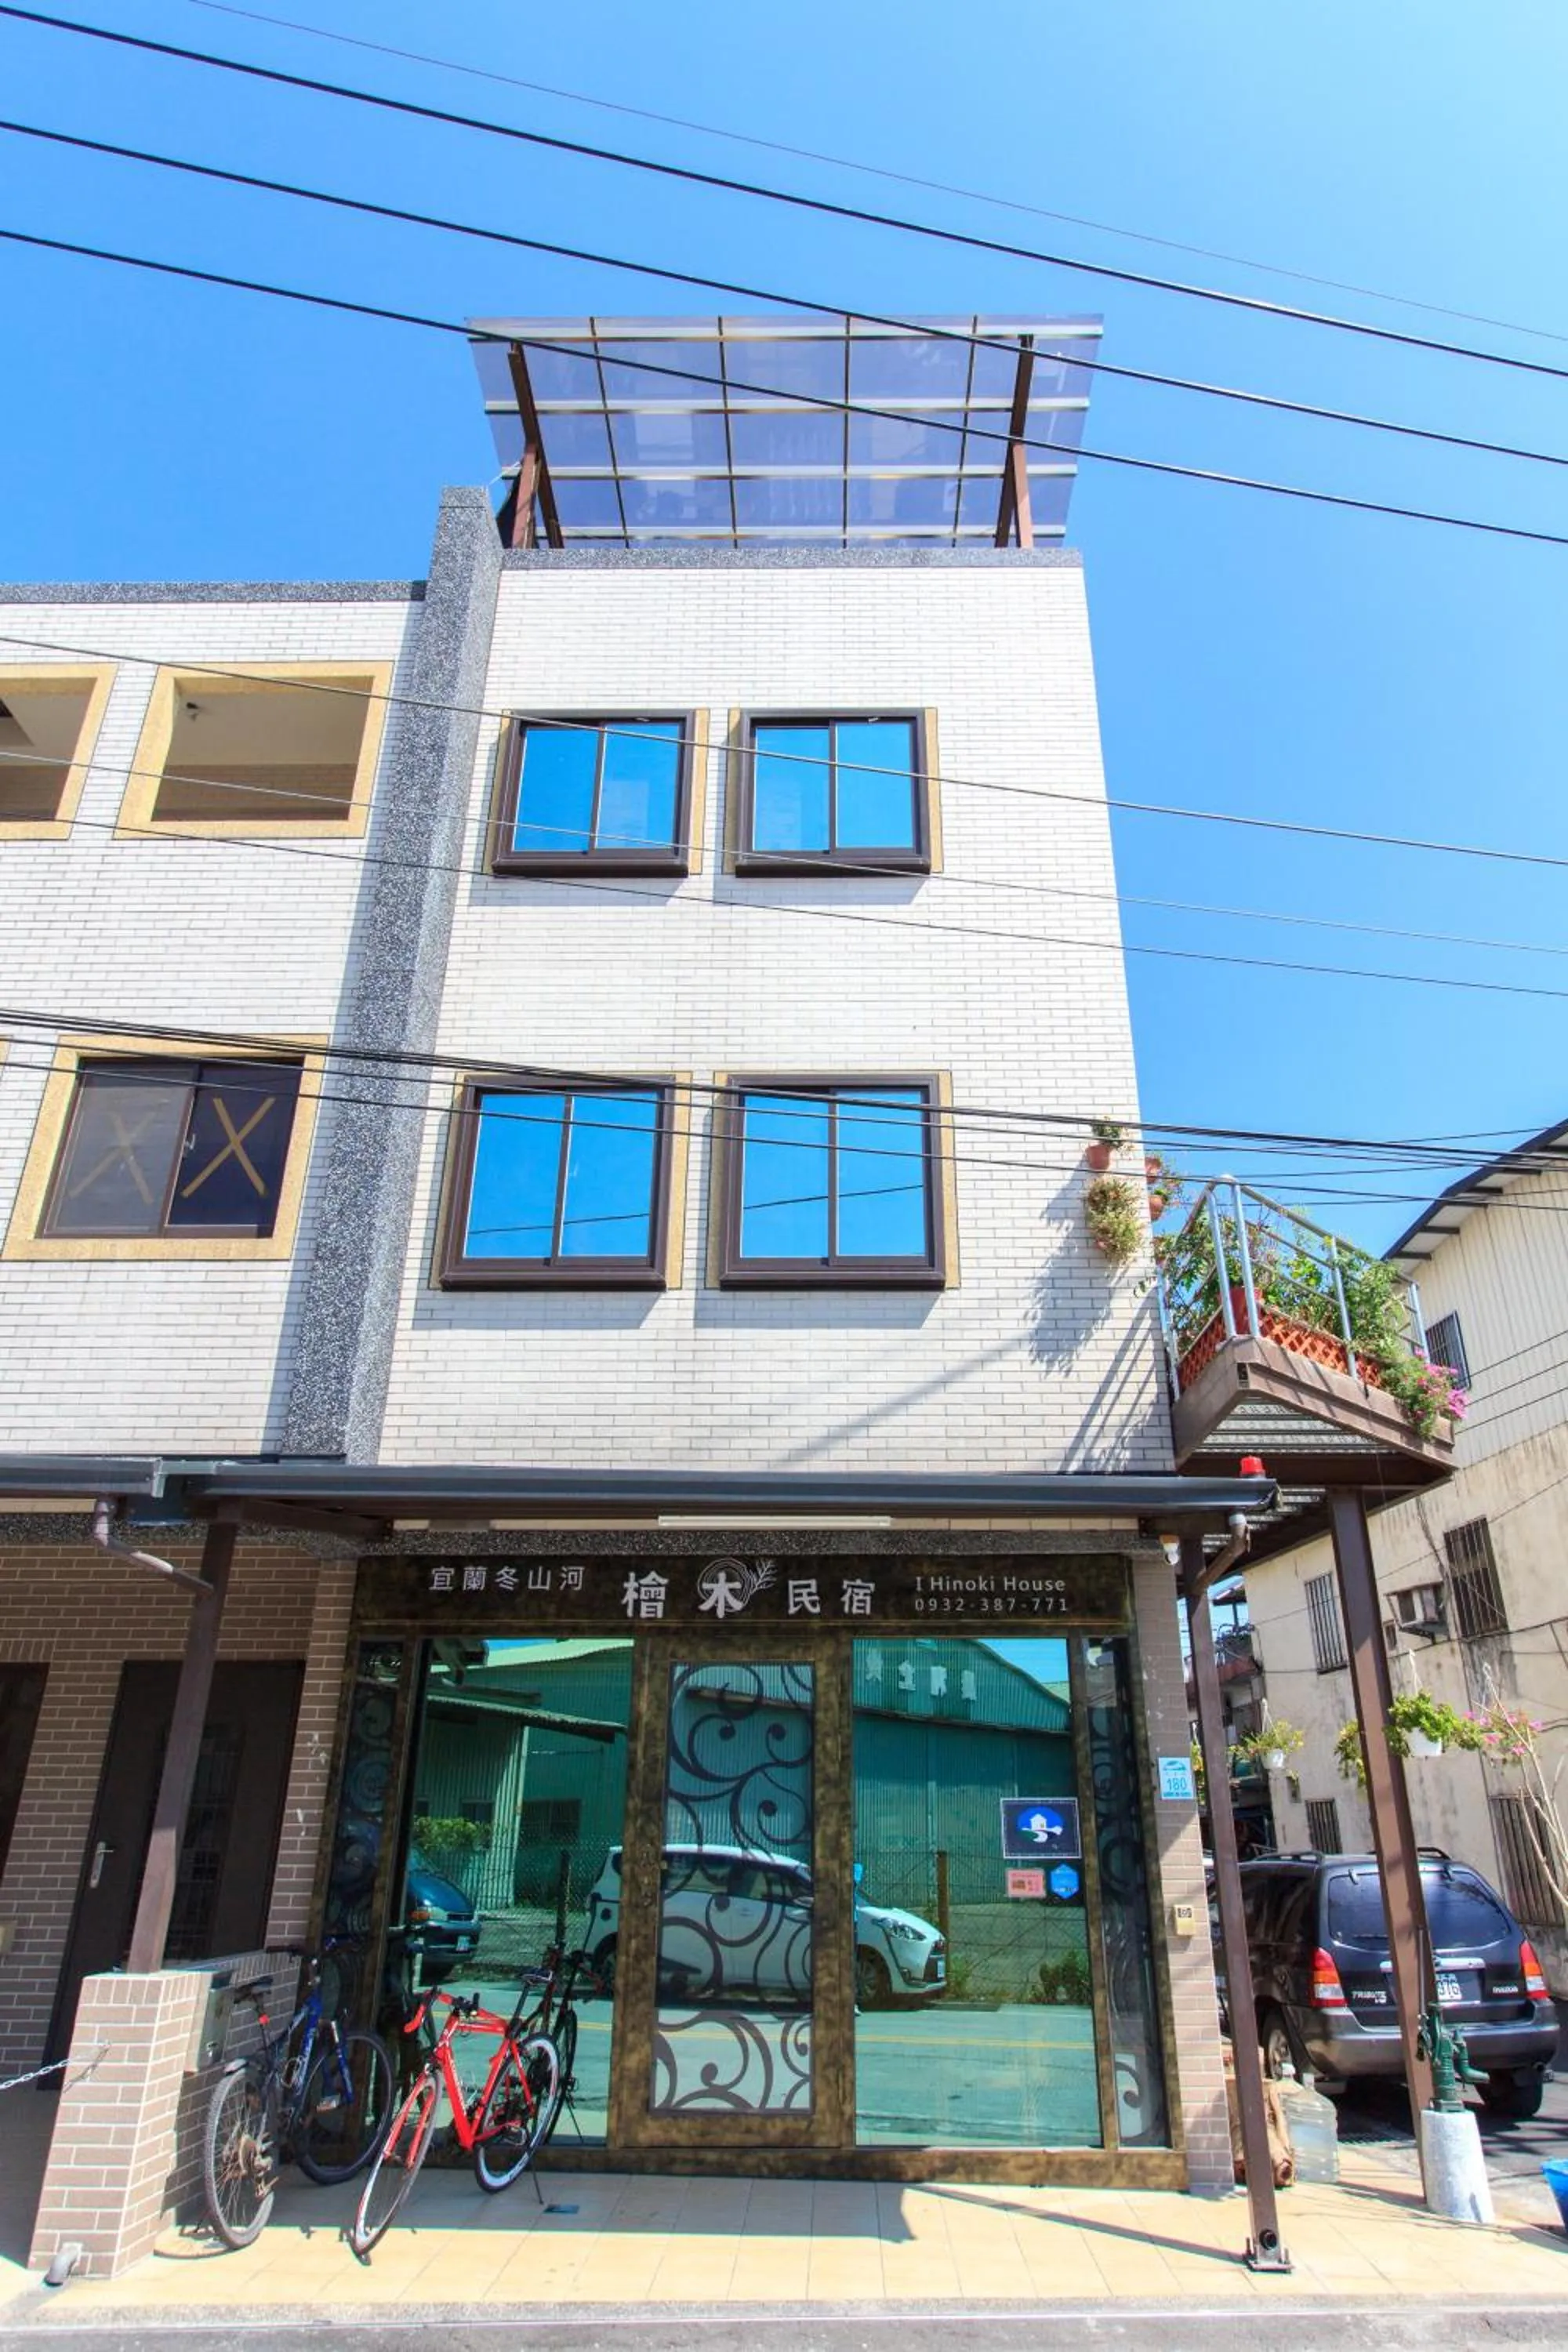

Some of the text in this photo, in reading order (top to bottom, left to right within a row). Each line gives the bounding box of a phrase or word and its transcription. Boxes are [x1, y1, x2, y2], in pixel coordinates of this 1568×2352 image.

[430, 1566, 876, 1618] 宜蘭冬山河 檜木民宿
[931, 1576, 995, 1592] Hinoki
[1004, 1576, 1066, 1592] House
[1167, 1777, 1186, 1791] 180
